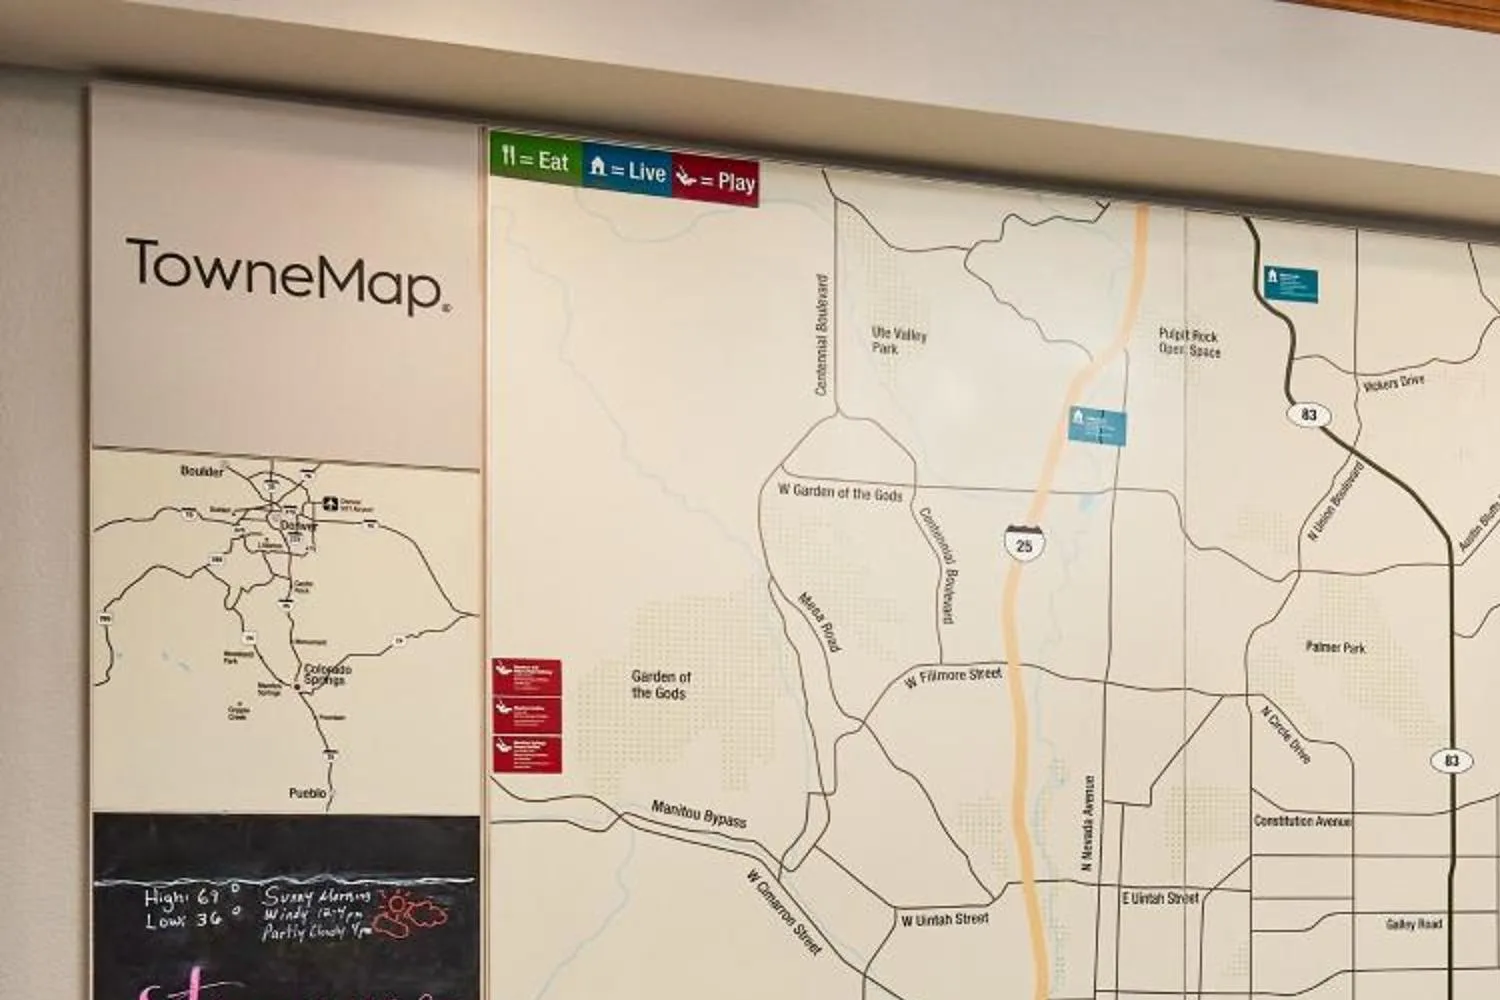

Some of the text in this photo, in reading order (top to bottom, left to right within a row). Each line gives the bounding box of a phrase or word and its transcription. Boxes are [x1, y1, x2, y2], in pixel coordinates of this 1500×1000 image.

[539, 152, 569, 172] Eat
[629, 161, 666, 182] Live
[719, 172, 756, 195] Play
[126, 237, 441, 318] TowneMap
[815, 274, 829, 396] Centennial Boulevard
[872, 326, 928, 345] Ute Valley
[1159, 327, 1218, 344] Pulpit Rock
[872, 342, 898, 355] Park
[1159, 342, 1221, 359] Open Space
[1364, 374, 1425, 393] Vickers Drive
[1302, 409, 1317, 421] 83
[181, 466, 224, 478] Boulder
[778, 483, 903, 502] W Garden of the Gods
[1016, 539, 1033, 553] 25
[919, 506, 958, 625] Centennial Boulevard
[798, 591, 842, 653] Mesa Road
[1306, 640, 1366, 654] Palmer Park
[631, 669, 692, 685] Garden of
[904, 667, 1003, 690] W Fillmore Street
[632, 685, 687, 701] the Gods
[1261, 706, 1311, 765] N Circle Drive
[1445, 755, 1459, 767] 83
[289, 788, 327, 799] Pueblo
[651, 799, 748, 830] Manitou Bypass
[1082, 775, 1095, 871] N Nevada Avenue
[1254, 814, 1351, 827] Constitution Avenue
[1123, 892, 1199, 905] E Uintah Street
[746, 868, 824, 956] W Cimarron Street
[901, 911, 990, 927] W Uintah Street
[1386, 918, 1443, 931] Galley Road
